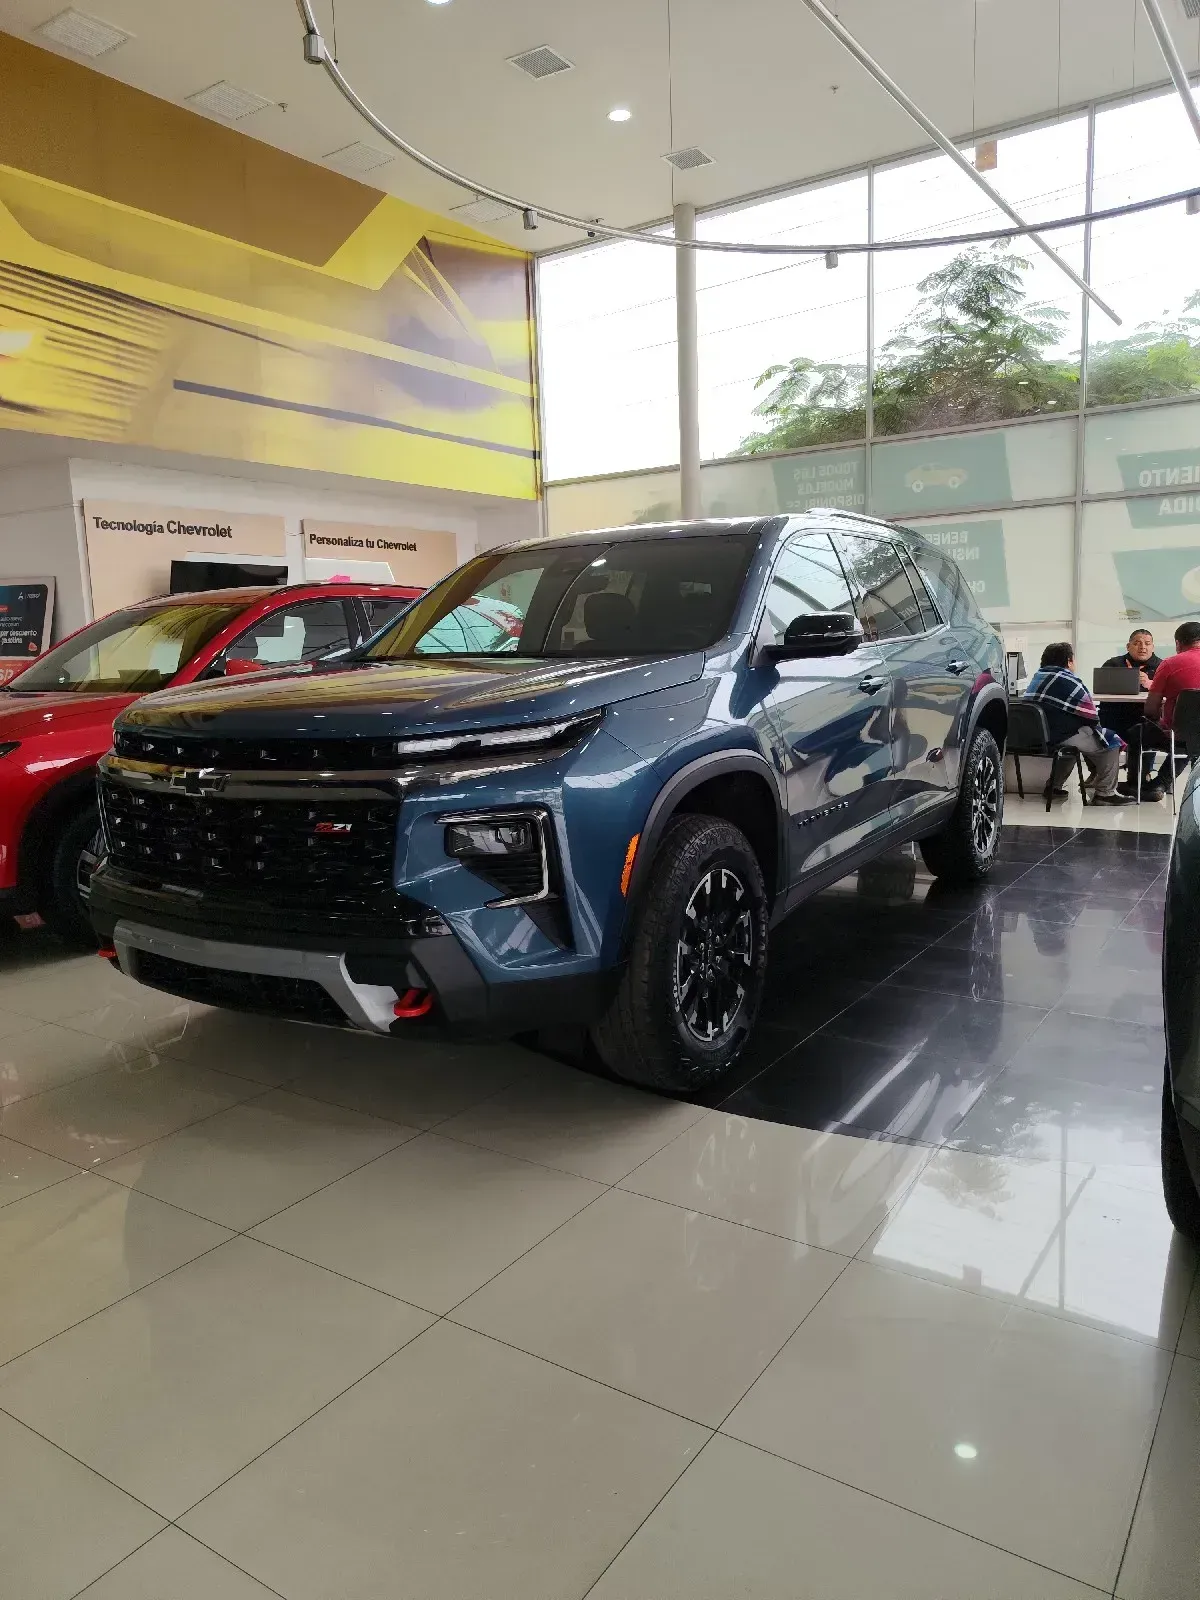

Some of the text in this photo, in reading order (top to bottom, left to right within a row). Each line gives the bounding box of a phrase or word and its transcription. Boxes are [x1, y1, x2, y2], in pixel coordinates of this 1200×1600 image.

[92, 516, 233, 538] Tecnología Chevrolet
[309, 533, 418, 552] Personaliza tu Chevrolet
